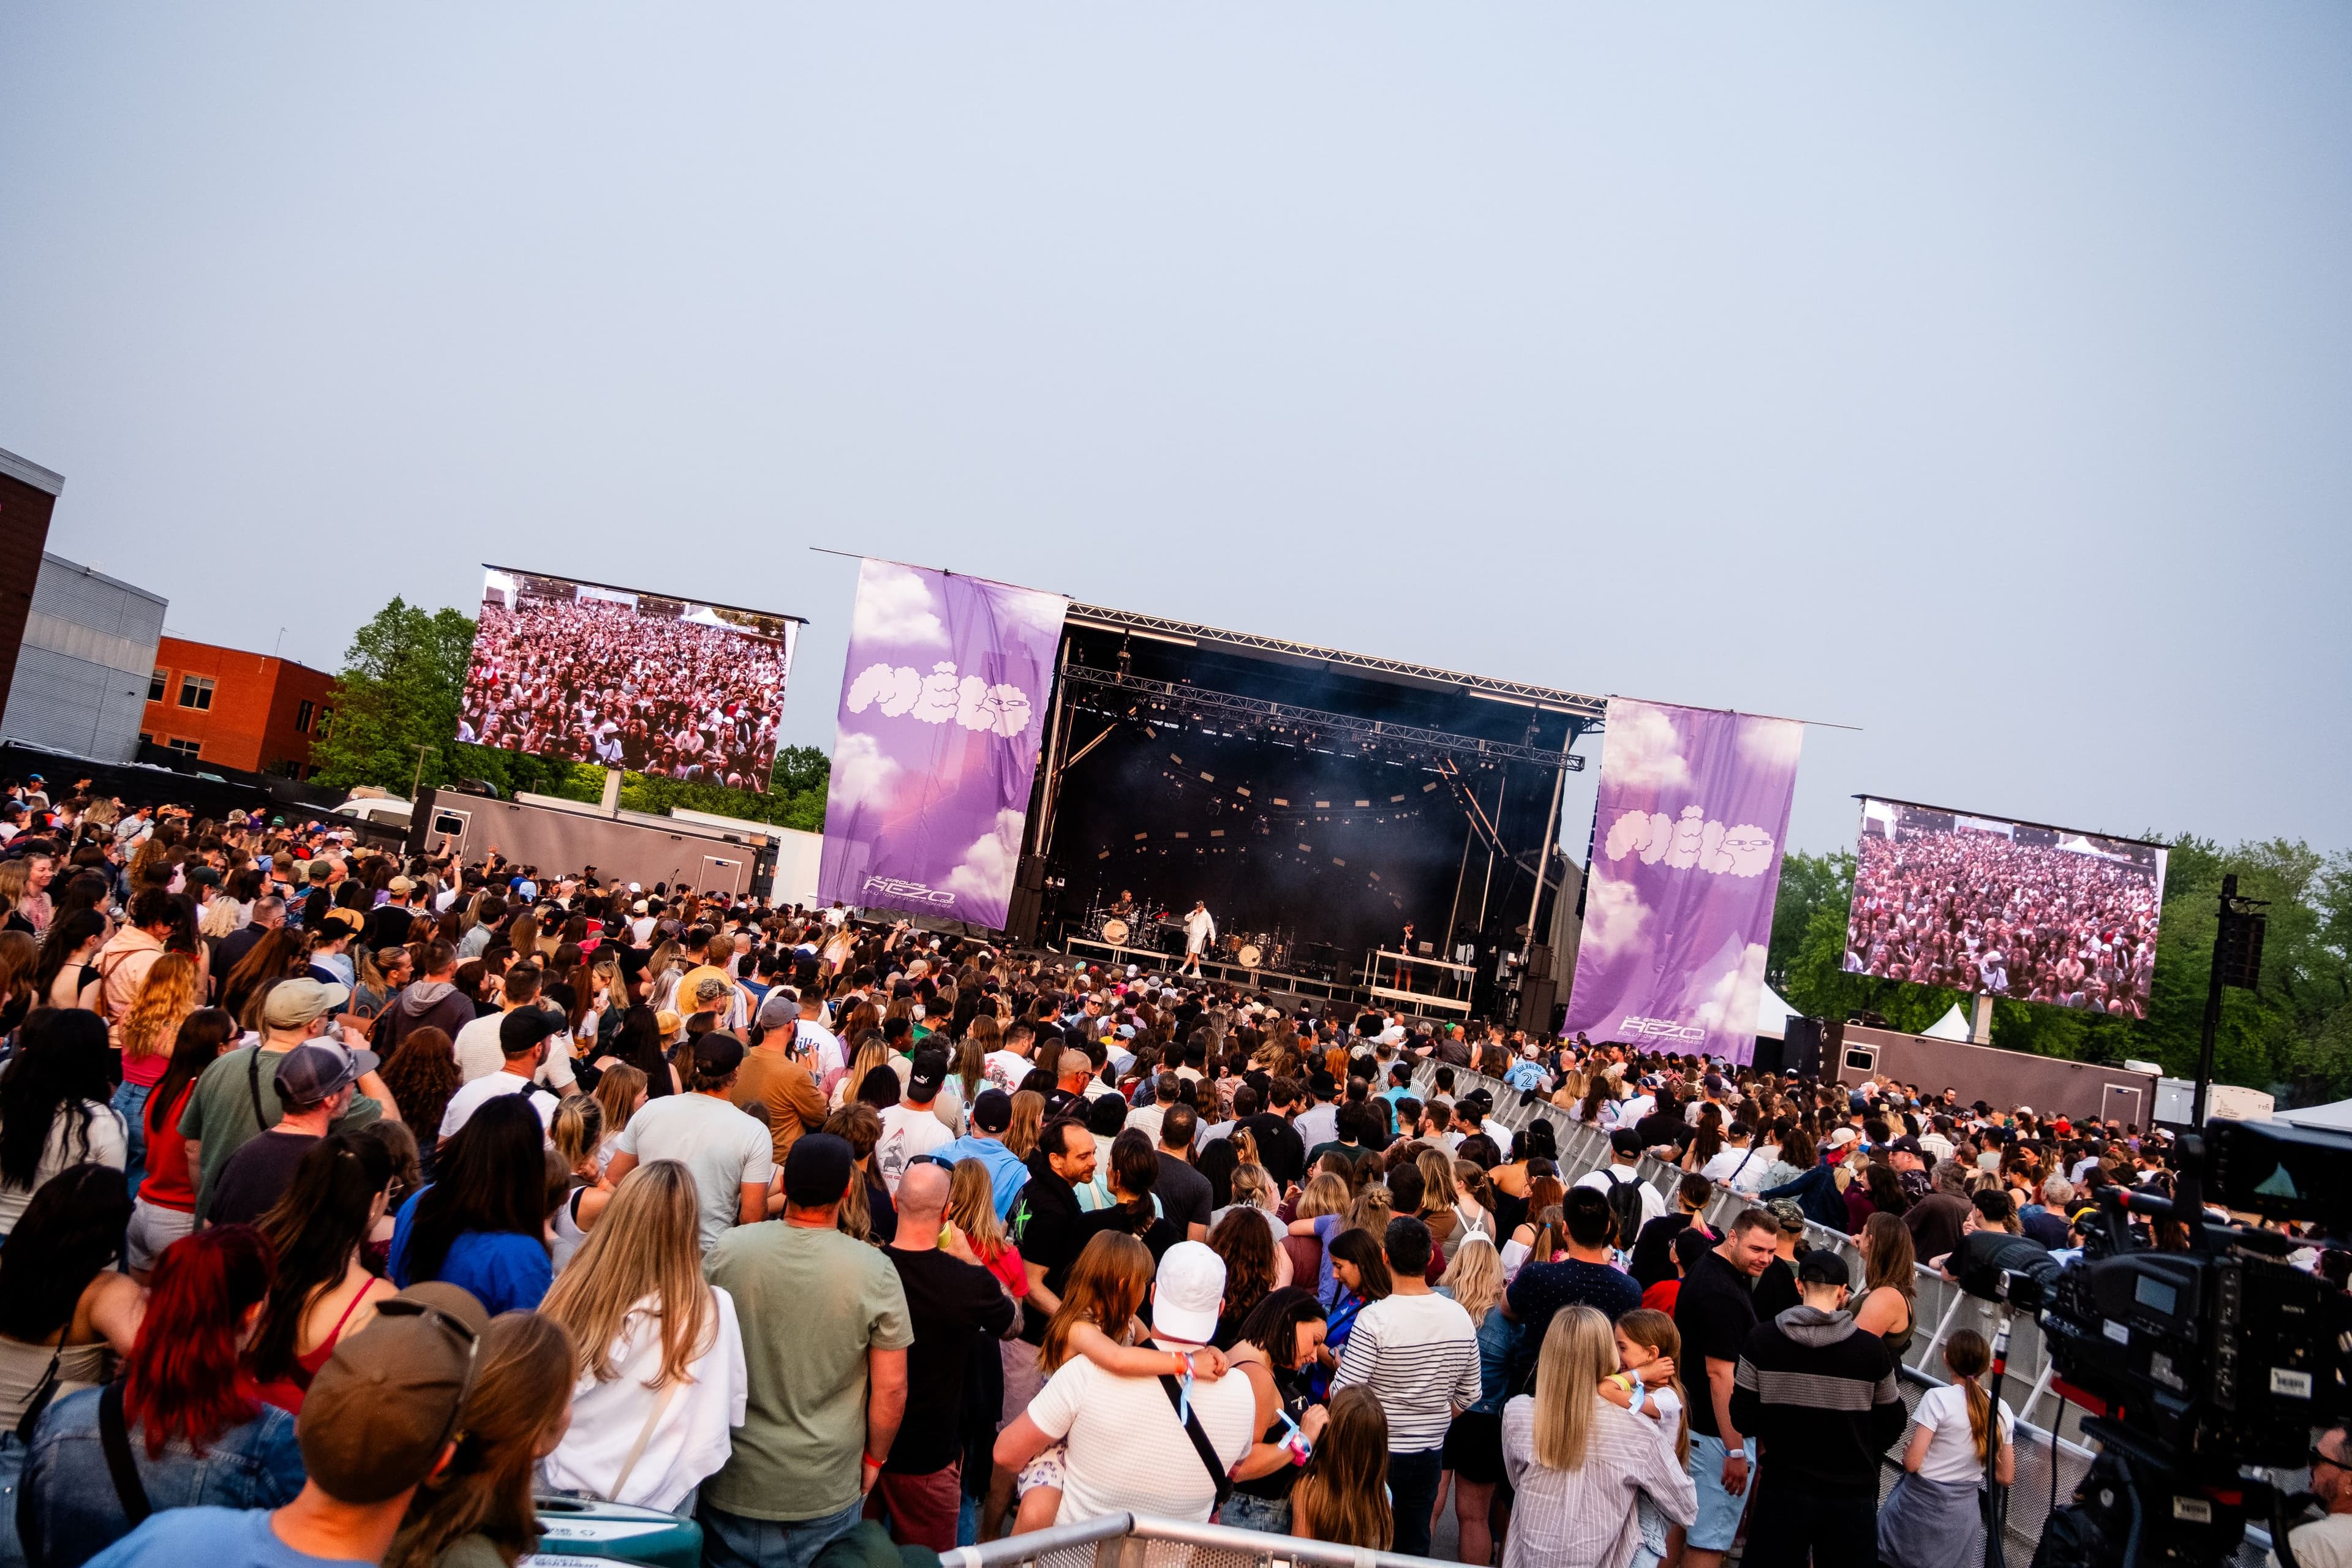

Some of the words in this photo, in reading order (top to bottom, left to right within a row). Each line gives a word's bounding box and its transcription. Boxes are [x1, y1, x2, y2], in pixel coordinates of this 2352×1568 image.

[884, 877, 927, 889] GROUPE
[1616, 1030, 1657, 1040] SOLUTIONS
[1516, 1063, 1542, 1074] GUERRERO
